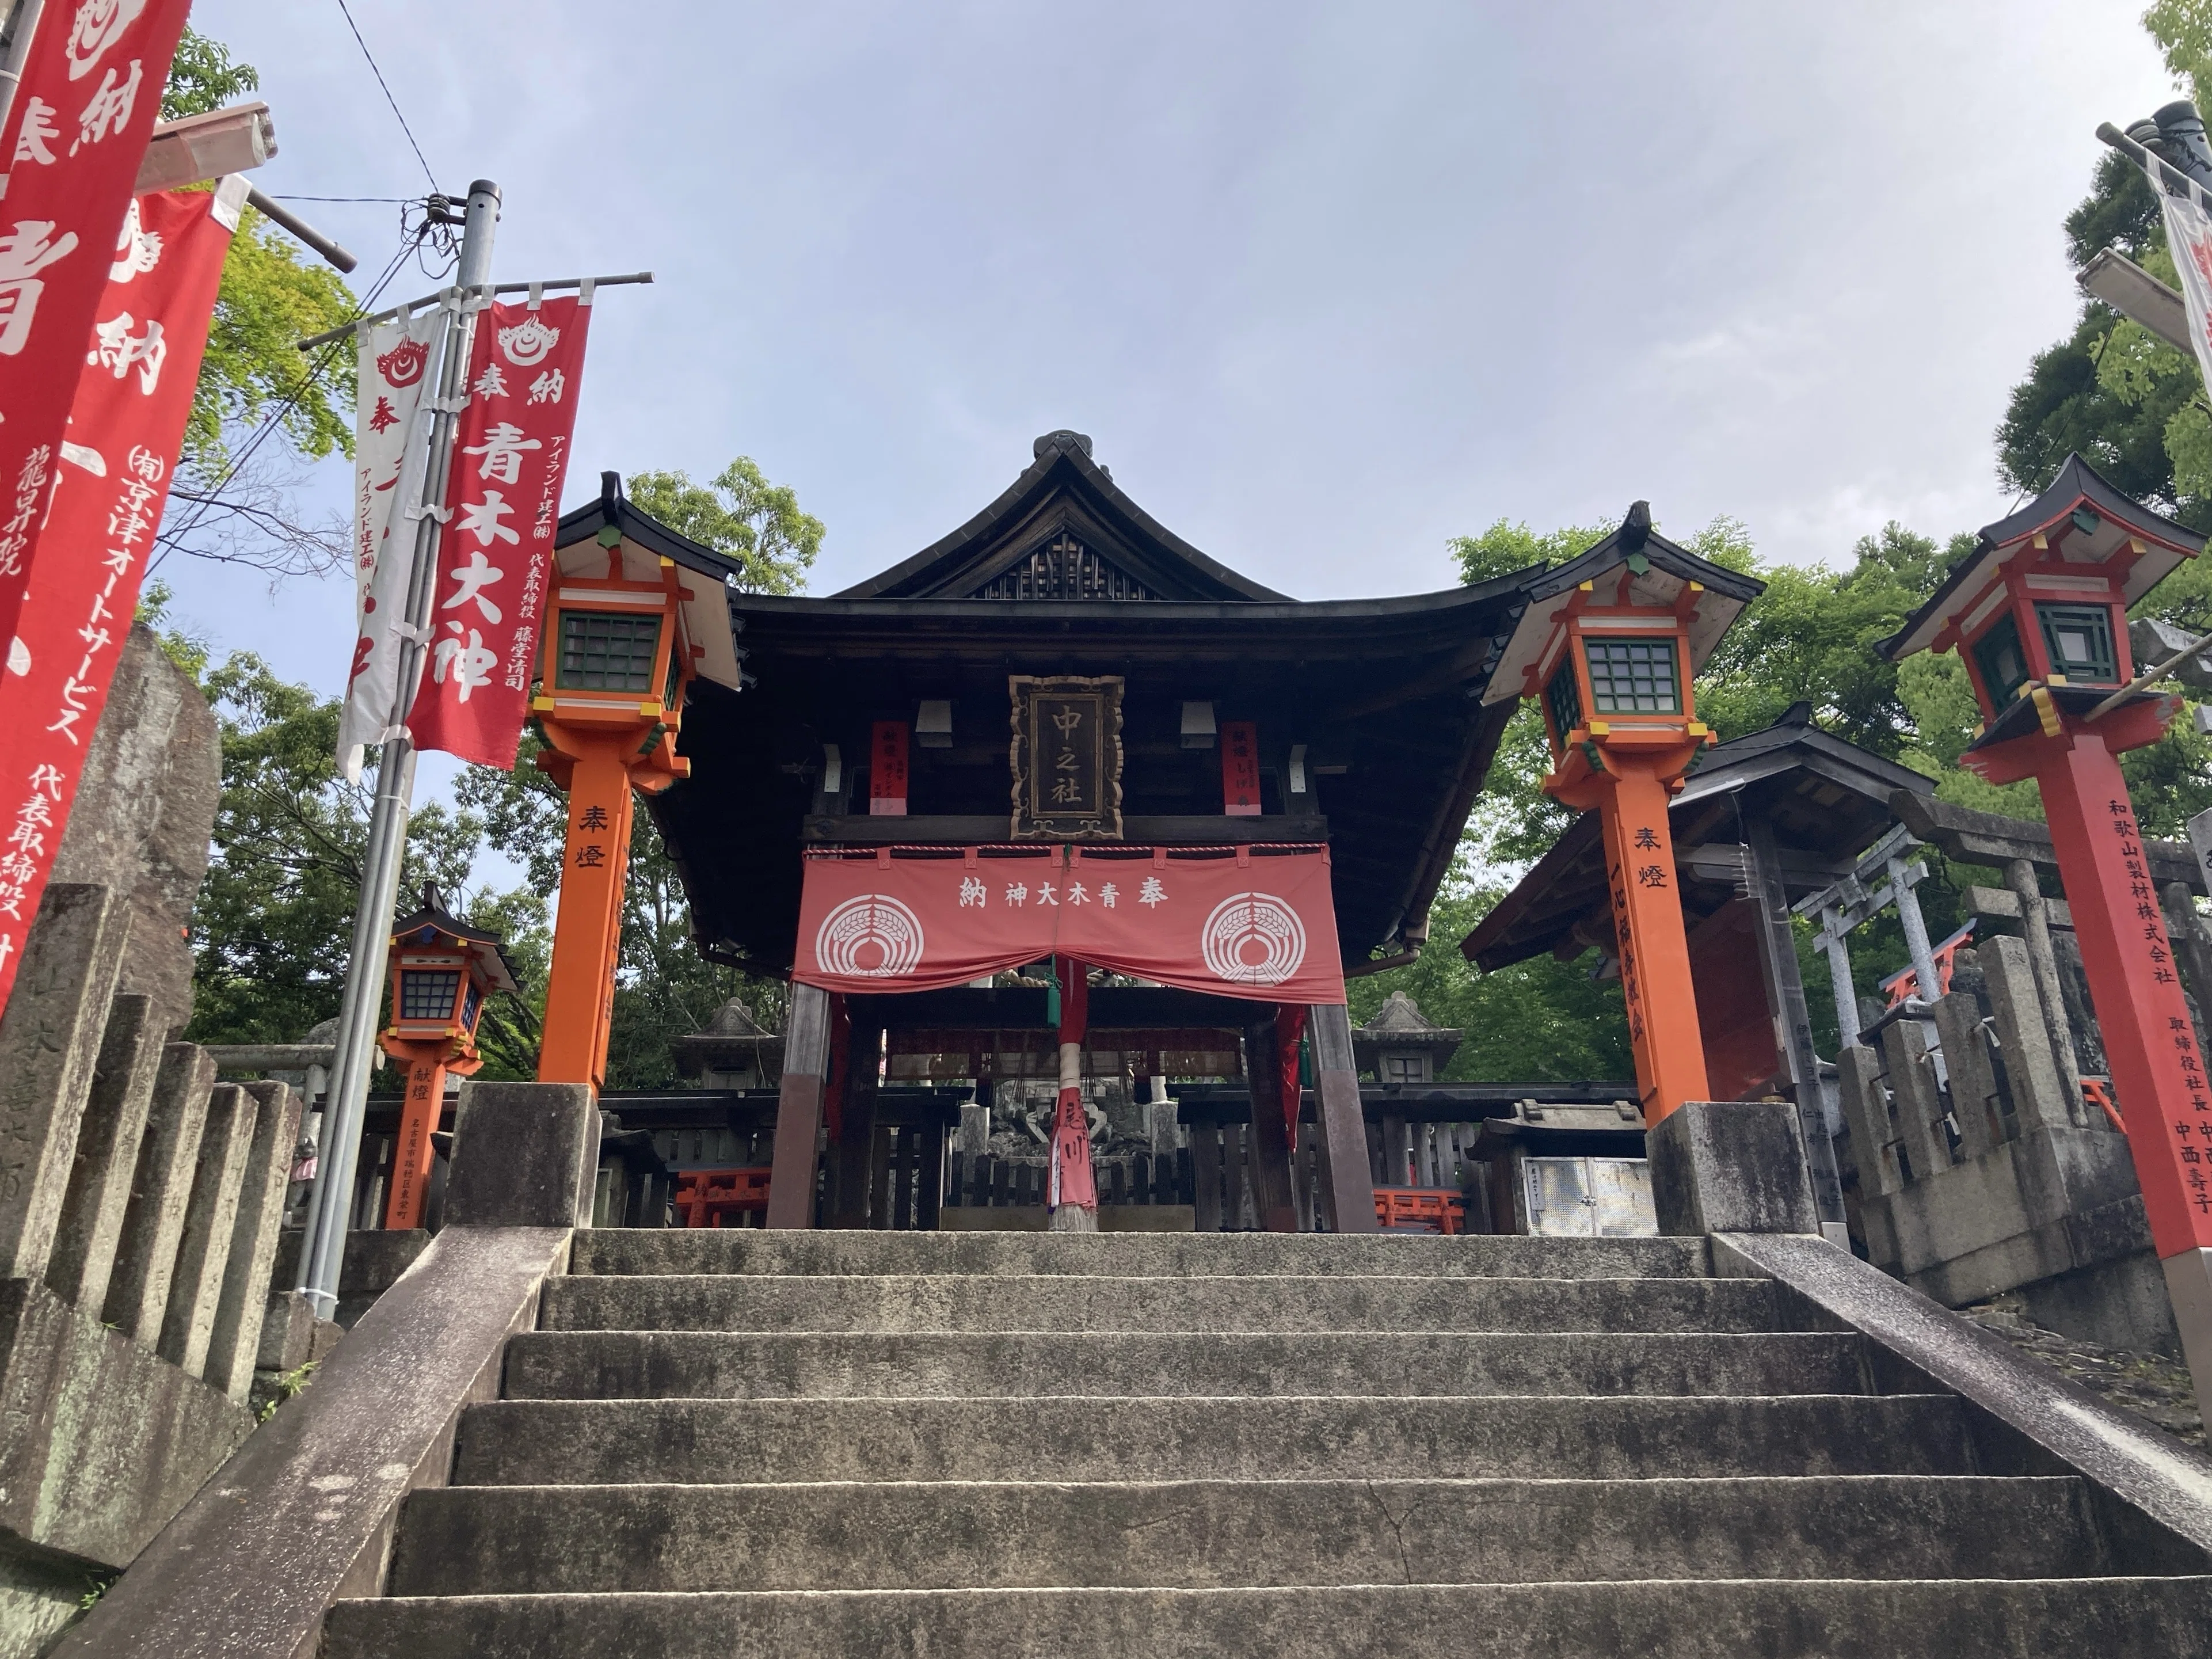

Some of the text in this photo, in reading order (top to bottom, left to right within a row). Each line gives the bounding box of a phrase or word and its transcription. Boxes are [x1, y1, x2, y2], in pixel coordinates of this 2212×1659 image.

[434, 422, 542, 705] 青木大神
[519, 554, 545, 619] 代表取締役
[1051, 705, 1082, 804] 中之社
[2109, 800, 2211, 1112] 和歌山製材株式会社 取締役社長
